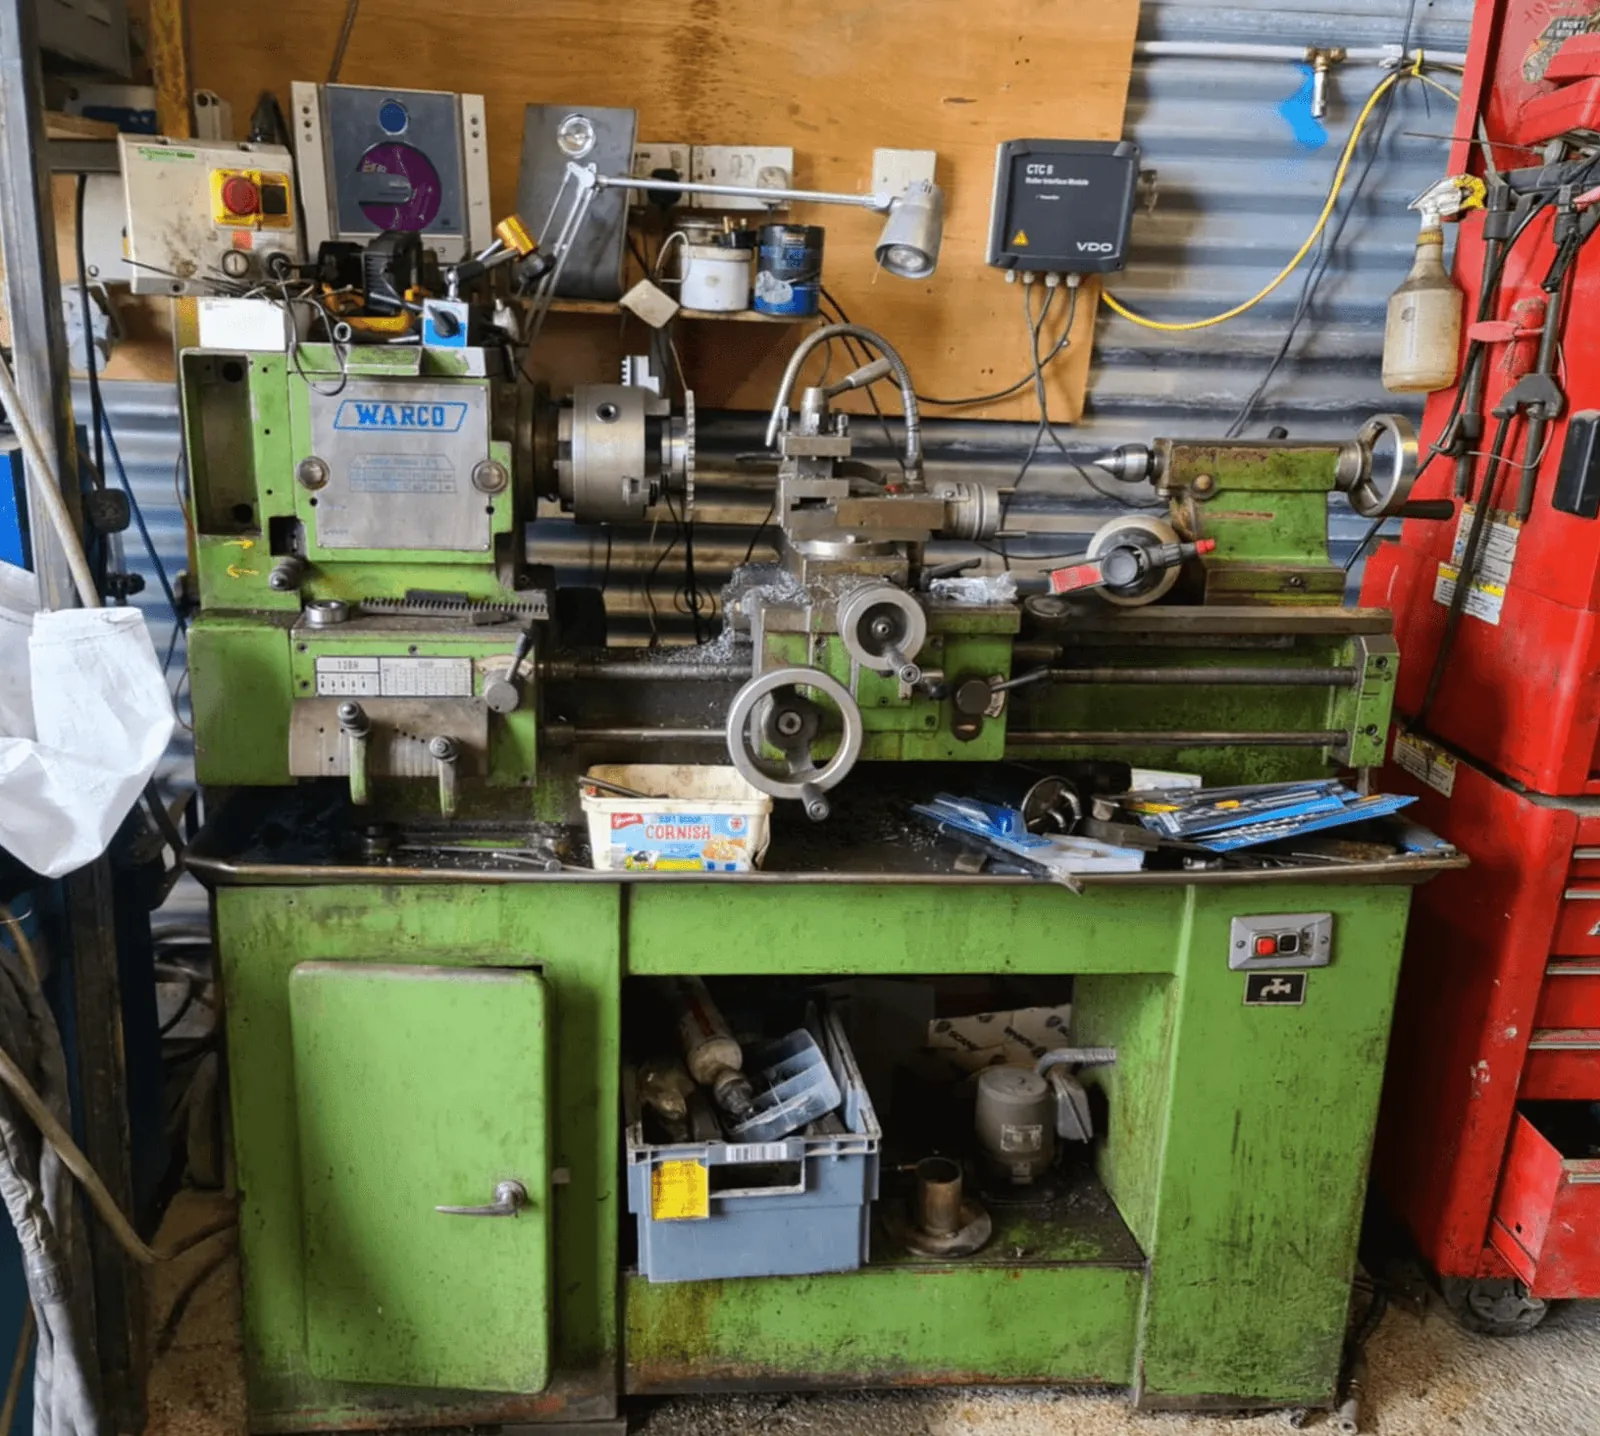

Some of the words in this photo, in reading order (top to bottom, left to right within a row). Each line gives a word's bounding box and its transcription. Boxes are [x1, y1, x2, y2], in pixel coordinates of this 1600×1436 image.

[1026, 163, 1046, 175] CTC
[1076, 241, 1113, 252] VDO
[355, 403, 446, 427] WARCO
[646, 825, 711, 839] CORNISH
